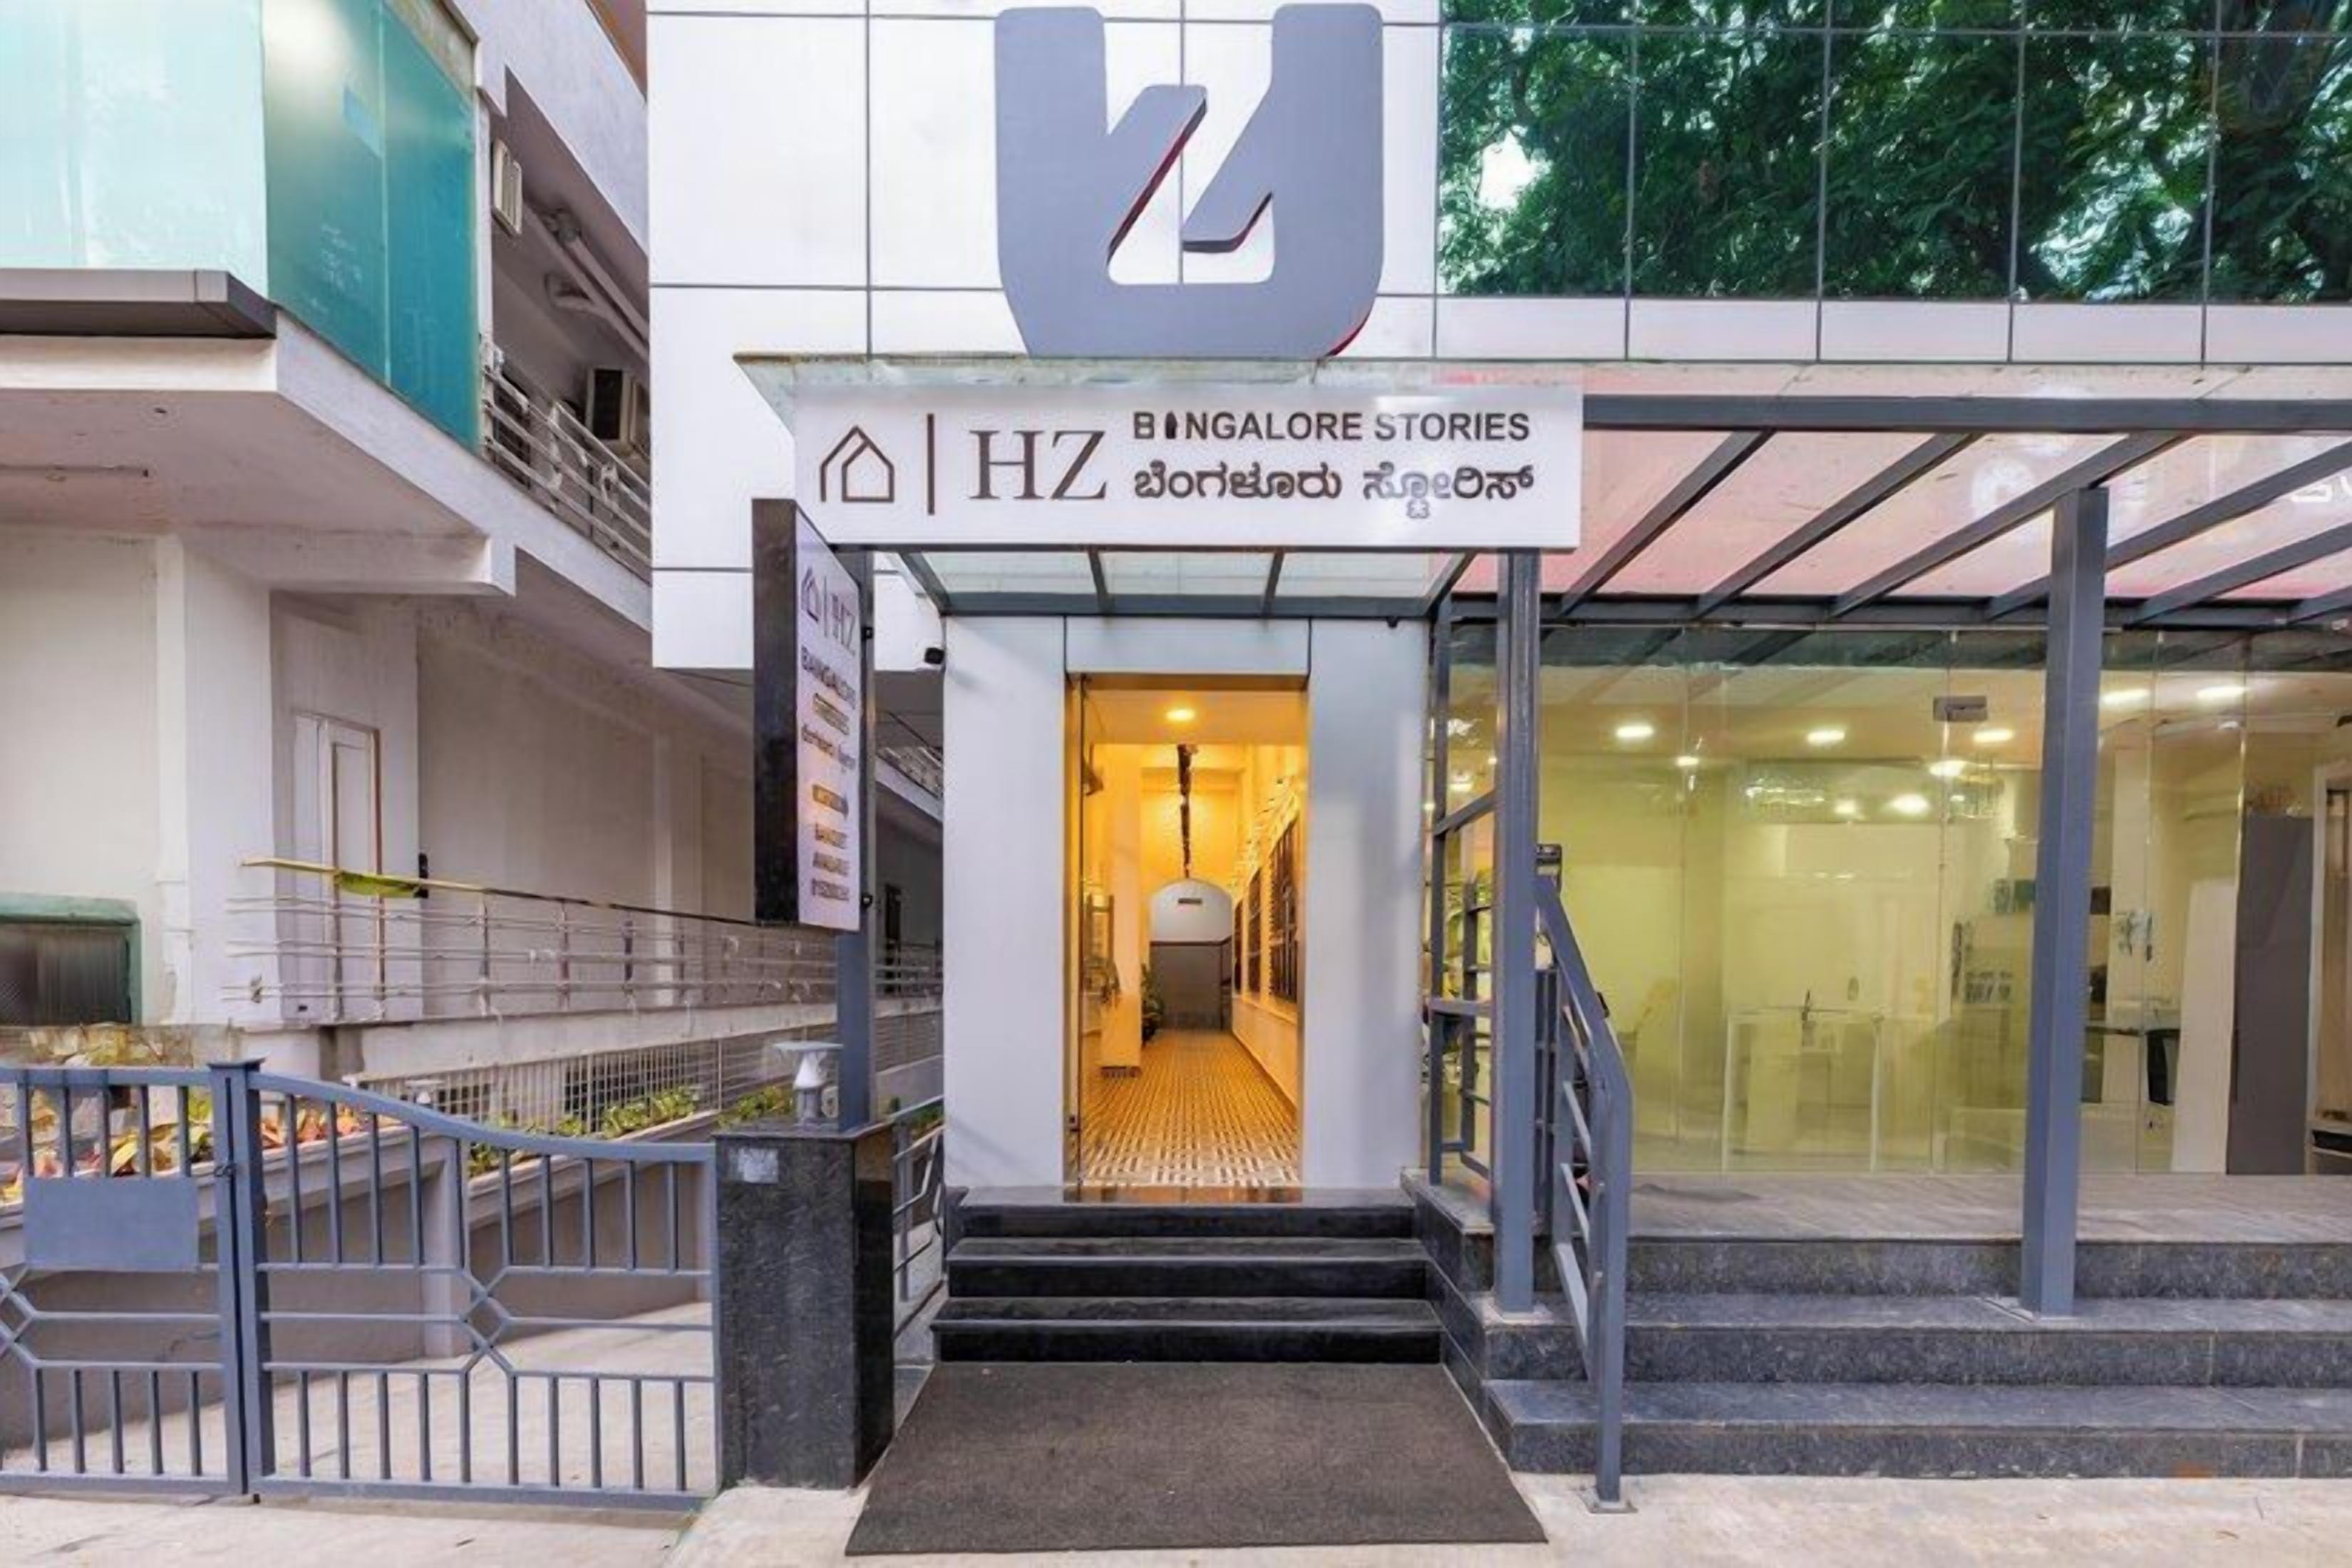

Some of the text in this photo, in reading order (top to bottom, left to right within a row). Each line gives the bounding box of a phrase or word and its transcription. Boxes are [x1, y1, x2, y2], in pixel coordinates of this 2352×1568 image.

[1374, 412, 1530, 441] STORIES
[969, 430, 1107, 500] HZ
[1135, 459, 1343, 498] ಬೆಂಗಳೂರು
